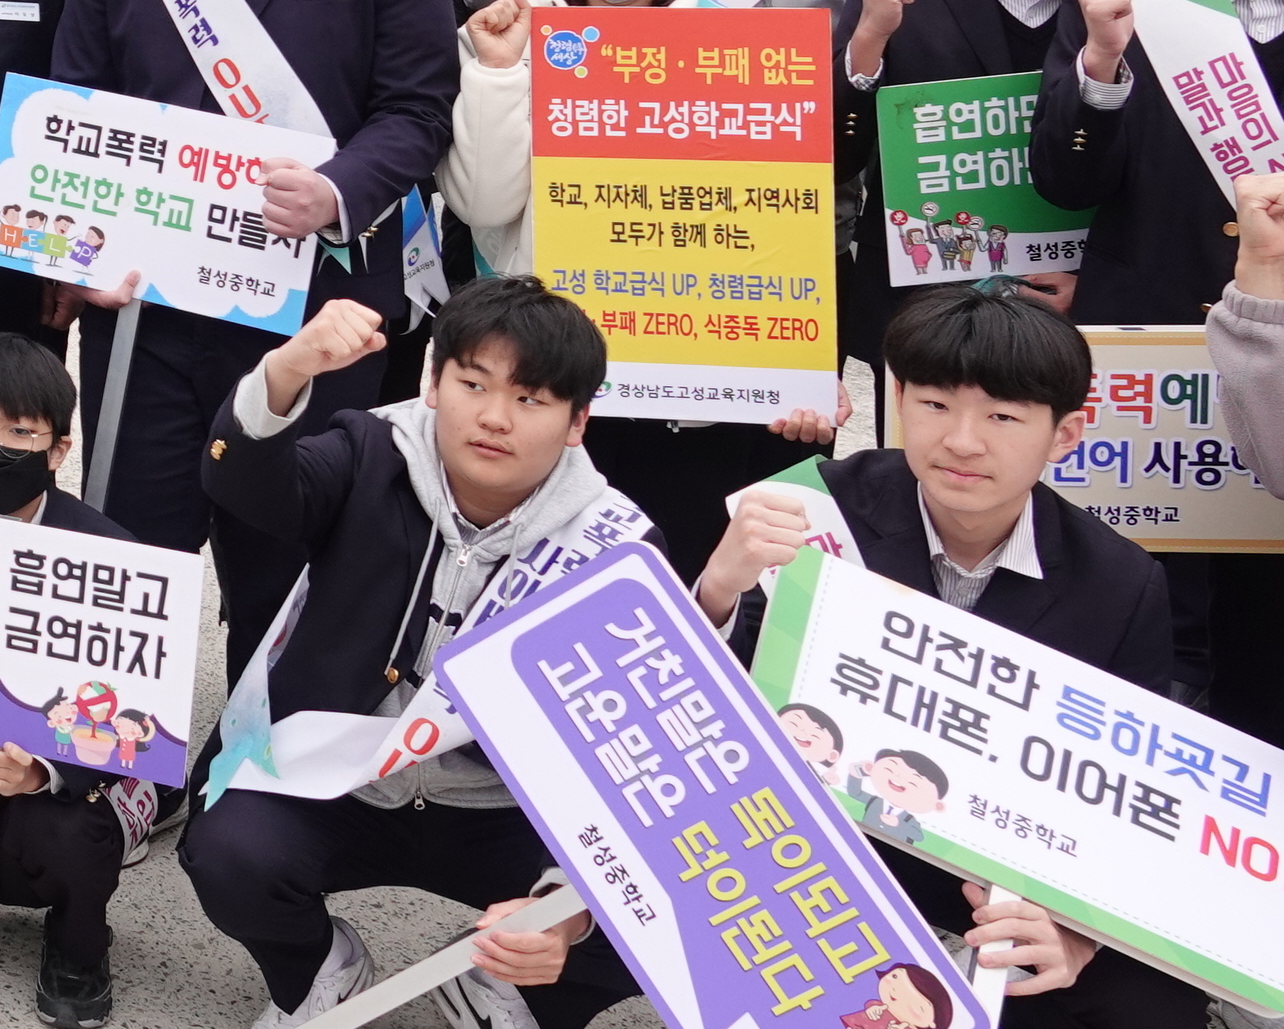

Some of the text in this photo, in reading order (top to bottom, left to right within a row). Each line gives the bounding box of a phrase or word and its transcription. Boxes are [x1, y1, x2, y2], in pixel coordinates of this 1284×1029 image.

[760, 47, 816, 85] 없는
[44, 114, 168, 174] 학교폭력
[547, 99, 628, 137] 청렴한
[29, 163, 124, 217] 안전한
[134, 187, 195, 233] 학교
[548, 183, 818, 214] 학교, 지자체, 납품업체, 지역사회
[609, 222, 755, 250] 모두가 함께 하는,
[196, 265, 276, 297] 철성중학교
[550, 271, 820, 303] 고성 학교급식 UP, 청렴급식 UP,
[643, 313, 698, 339] ZERO,
[704, 315, 760, 341] 식중독
[767, 318, 818, 341] ZERO
[617, 383, 780, 405] 경상남도고성교육지원청
[10, 549, 170, 622] 흡연말고
[4, 605, 167, 680] 금연하자
[879, 610, 1273, 818] 안전한 등하굣길
[604, 606, 891, 986] 거친말은 독이되고
[1019, 734, 1182, 844] 이어폰
[536, 641, 687, 829] 고운말은
[671, 819, 825, 1017] 덕이된다
[965, 792, 1079, 859] 철성중학교
[576, 824, 658, 927] 철성중학교
